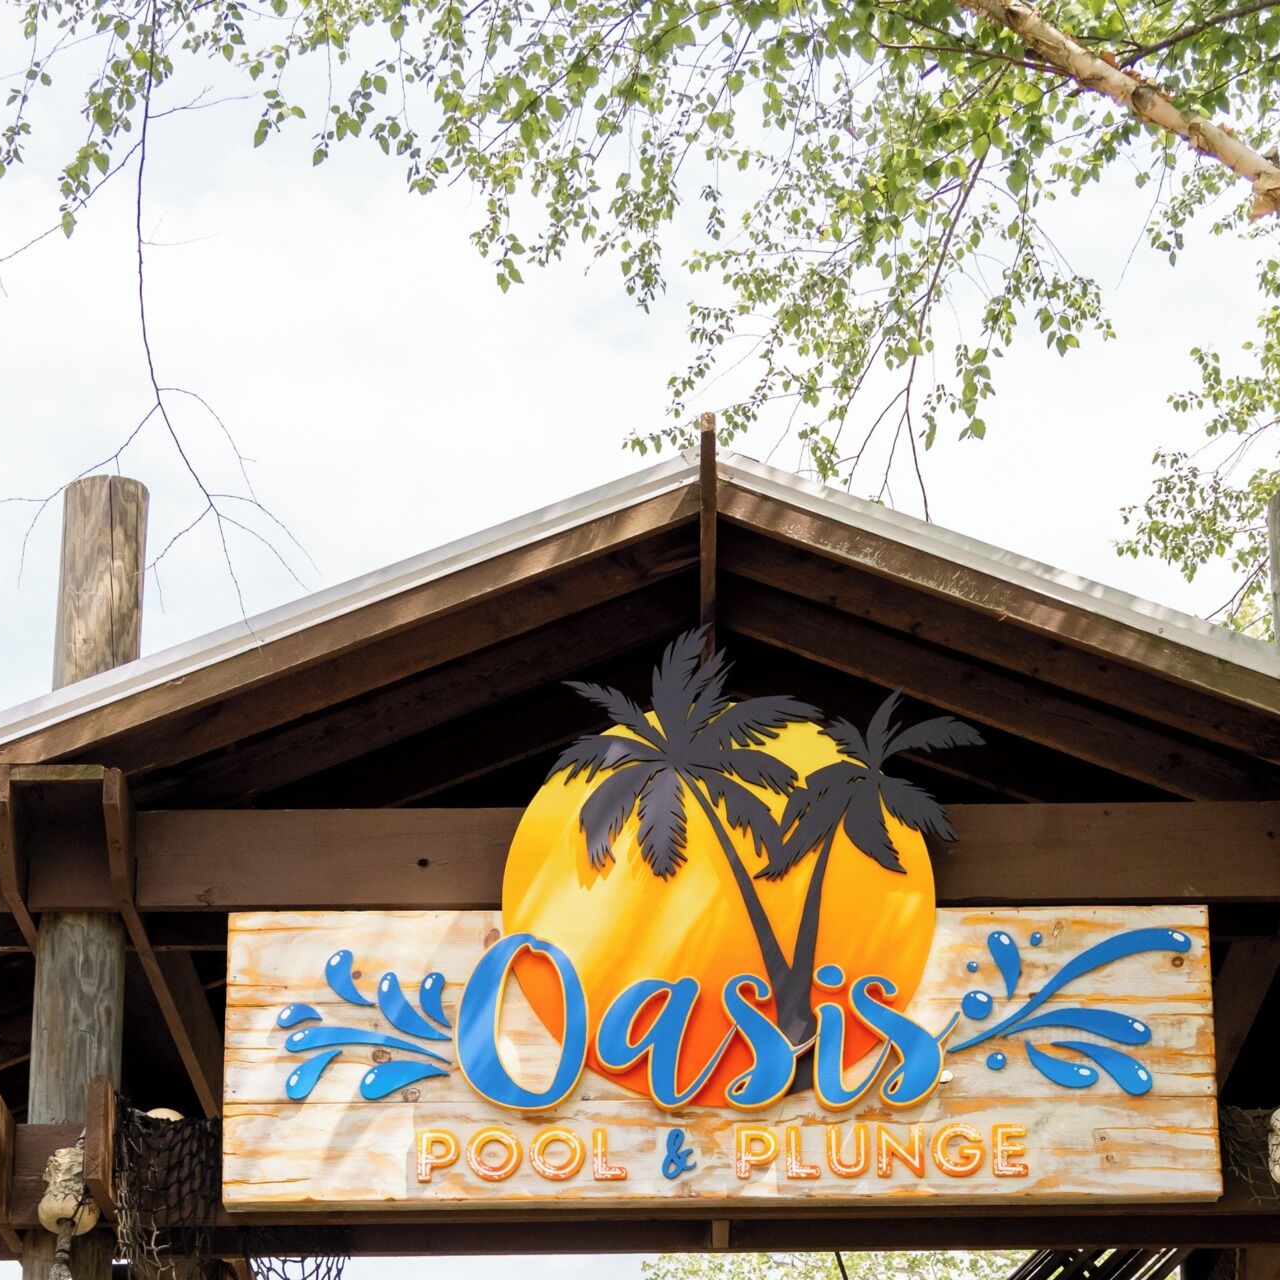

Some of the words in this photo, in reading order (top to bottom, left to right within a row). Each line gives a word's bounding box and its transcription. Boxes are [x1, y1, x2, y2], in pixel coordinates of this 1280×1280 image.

[455, 932, 960, 1112] Oasis
[417, 1126, 627, 1183] POOL
[661, 1128, 697, 1180] &
[736, 1123, 1030, 1179] PLUNGE
